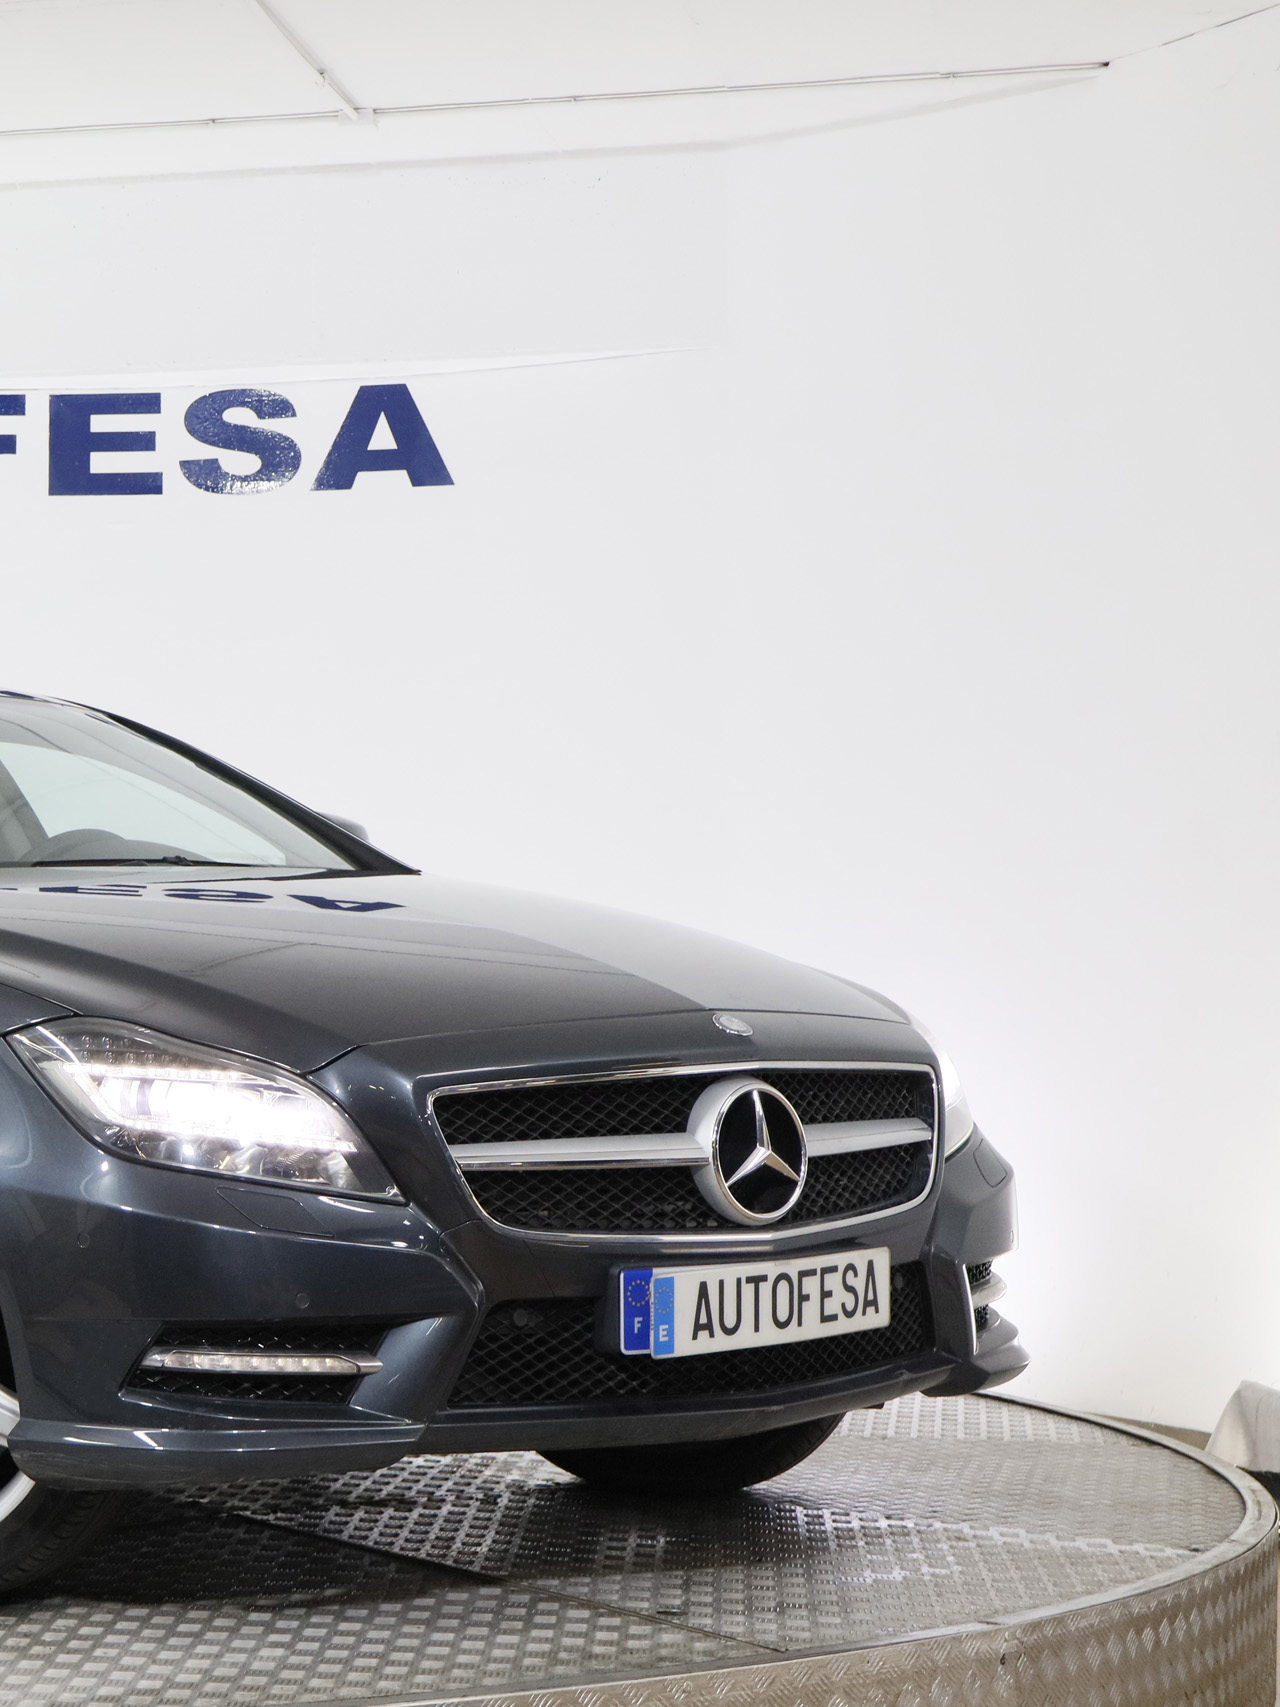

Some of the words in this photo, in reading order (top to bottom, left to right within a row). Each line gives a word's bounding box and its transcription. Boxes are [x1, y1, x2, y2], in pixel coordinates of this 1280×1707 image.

[693, 1259, 880, 1341] AUTOFESA
[634, 1316, 643, 1334] F
[659, 1324, 669, 1342] E
